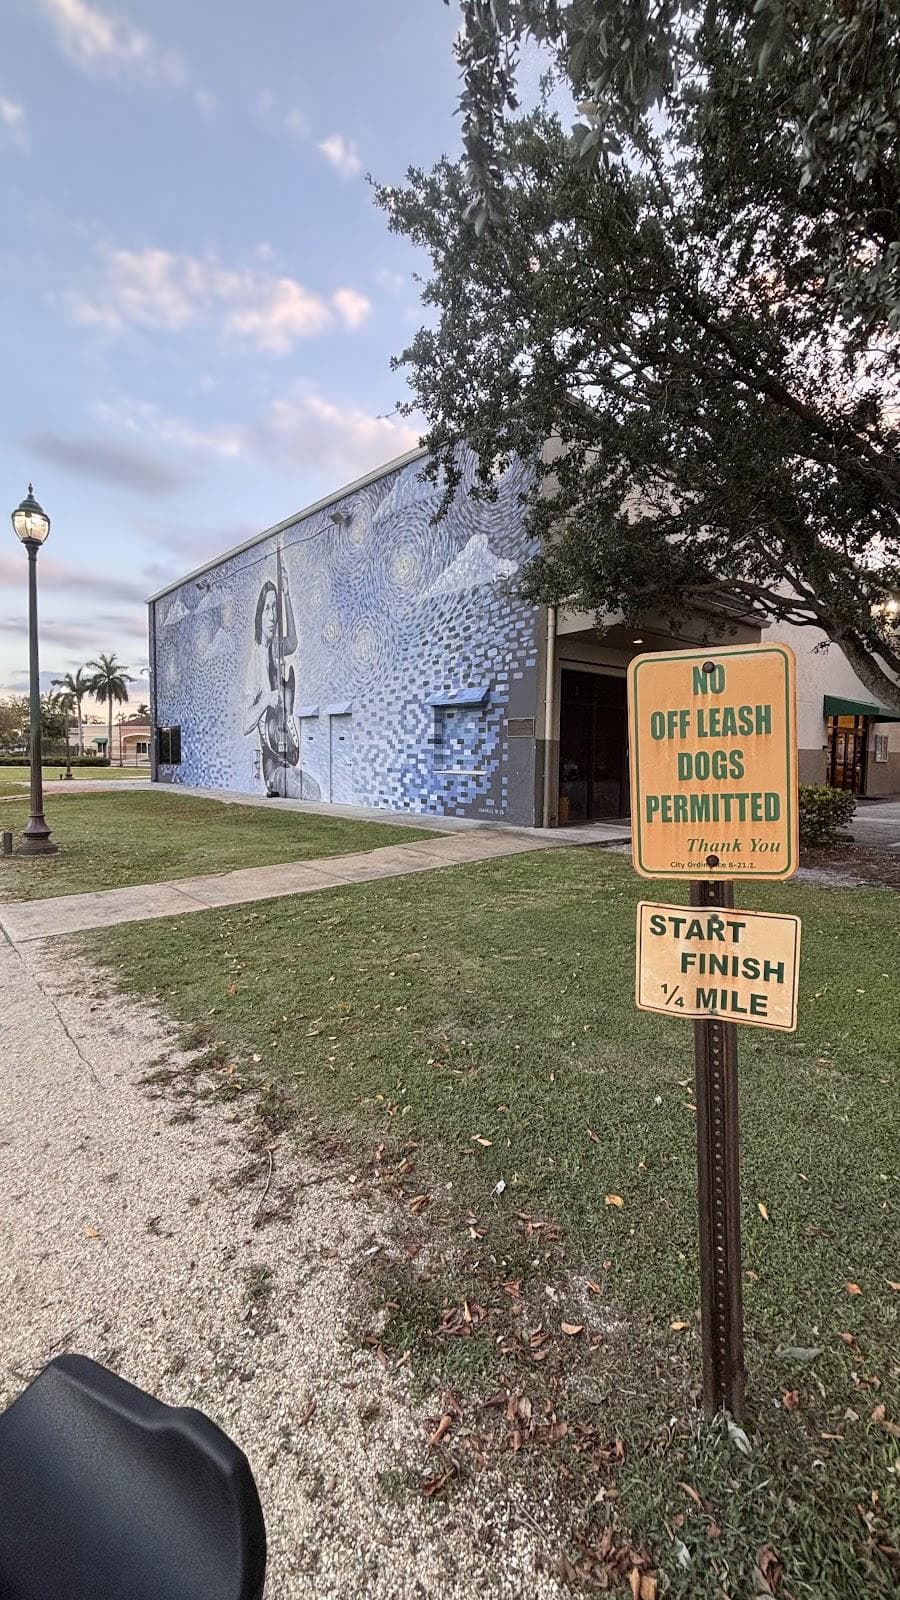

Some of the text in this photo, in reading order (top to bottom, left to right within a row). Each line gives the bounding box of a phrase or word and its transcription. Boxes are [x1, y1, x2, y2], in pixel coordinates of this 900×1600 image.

[693, 664, 726, 695] NO
[651, 705, 772, 741] OFF LEASH
[678, 750, 745, 781] DOGS
[646, 792, 781, 823] PERMITTED
[687, 838, 781, 853] Thank You
[670, 861, 685, 869] City
[687, 861, 726, 869] Ordince
[650, 914, 746, 943] START
[680, 952, 785, 984] FINISH
[695, 987, 769, 1017] MILE
